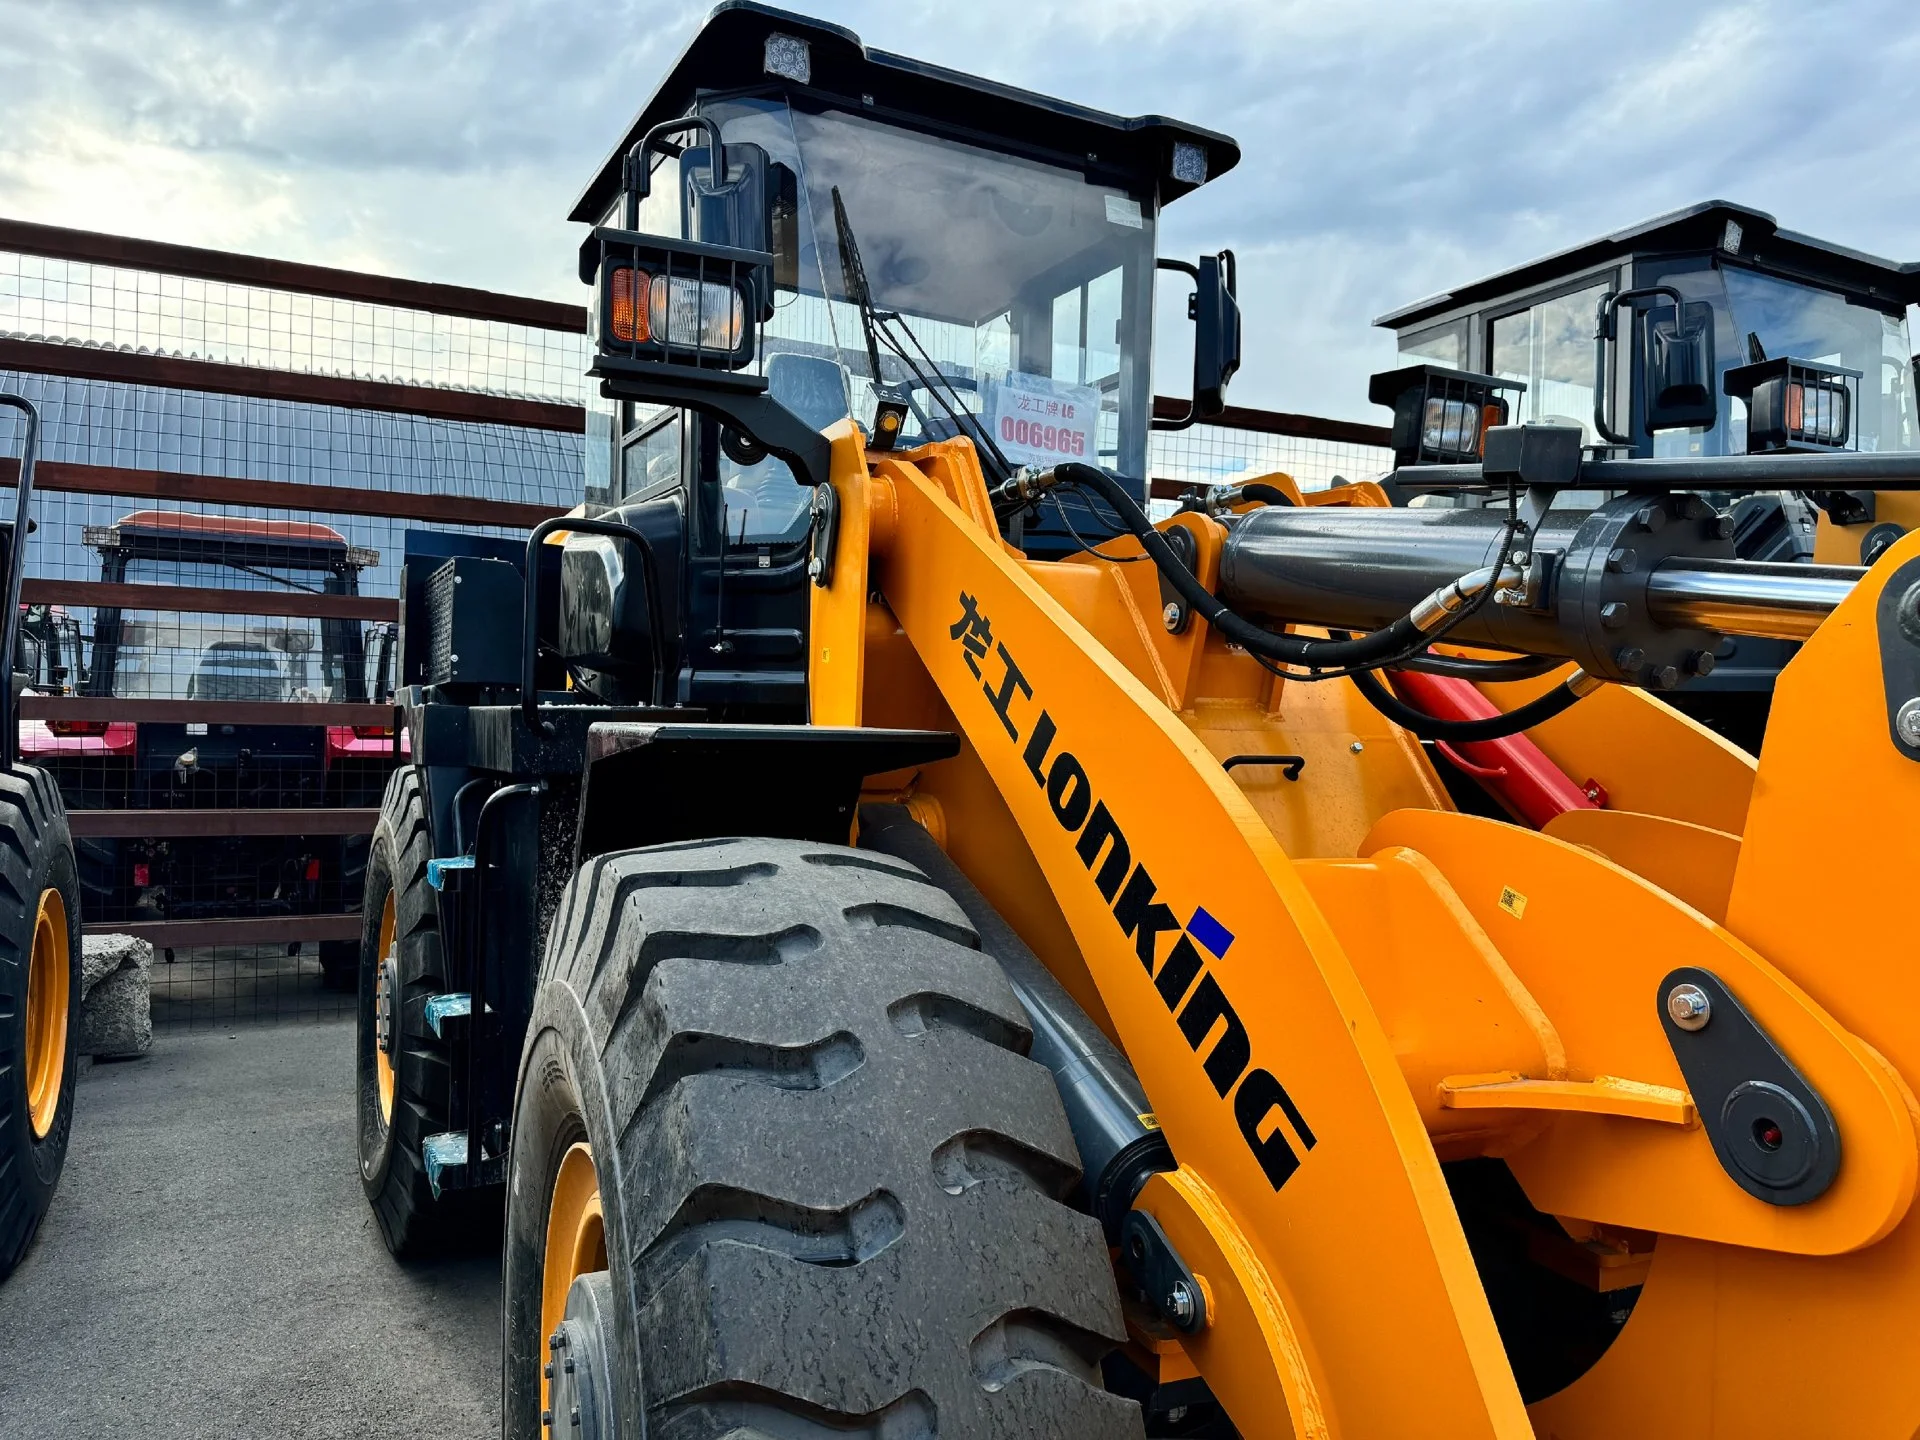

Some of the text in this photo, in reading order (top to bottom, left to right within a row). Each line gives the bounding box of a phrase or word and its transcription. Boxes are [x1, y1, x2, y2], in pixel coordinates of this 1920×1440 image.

[1017, 394, 1059, 417] 龙工牌
[1001, 415, 1085, 457] 006965
[949, 590, 1034, 744] 龙工
